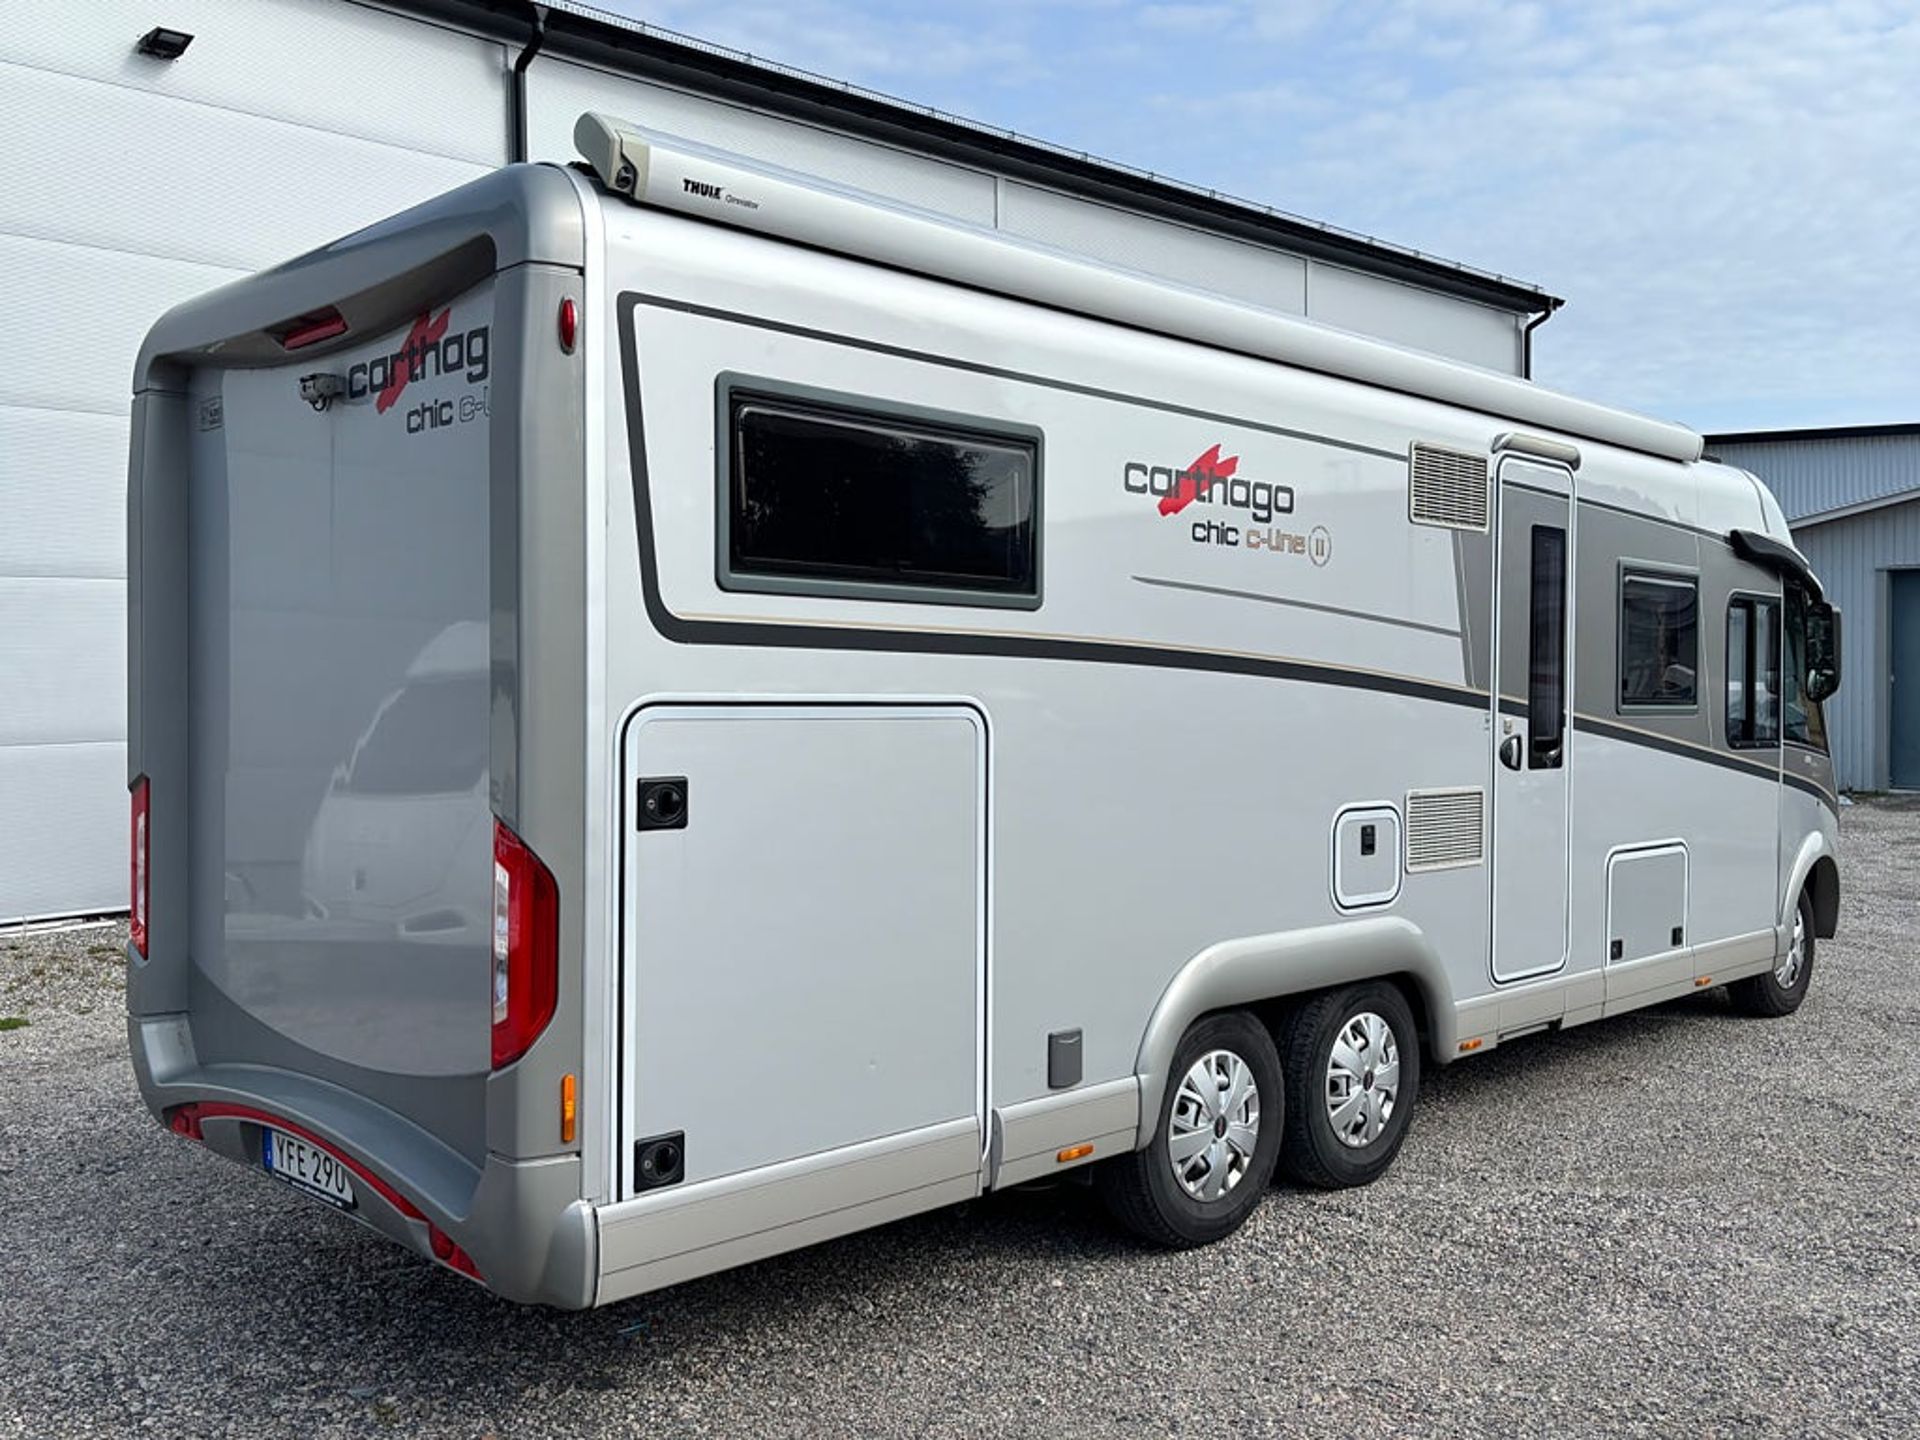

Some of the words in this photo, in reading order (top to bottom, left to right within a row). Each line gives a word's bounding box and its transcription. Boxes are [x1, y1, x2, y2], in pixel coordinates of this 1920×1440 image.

[683, 178, 723, 200] THULE
[349, 327, 490, 398] carthag
[407, 399, 453, 433] chic
[459, 386, 491, 423] c-l
[1124, 463, 1294, 523] carthago
[1192, 520, 1239, 546] chic
[1246, 528, 1306, 555] c-line
[276, 1135, 306, 1177] YFE
[312, 1152, 345, 1193] 290
